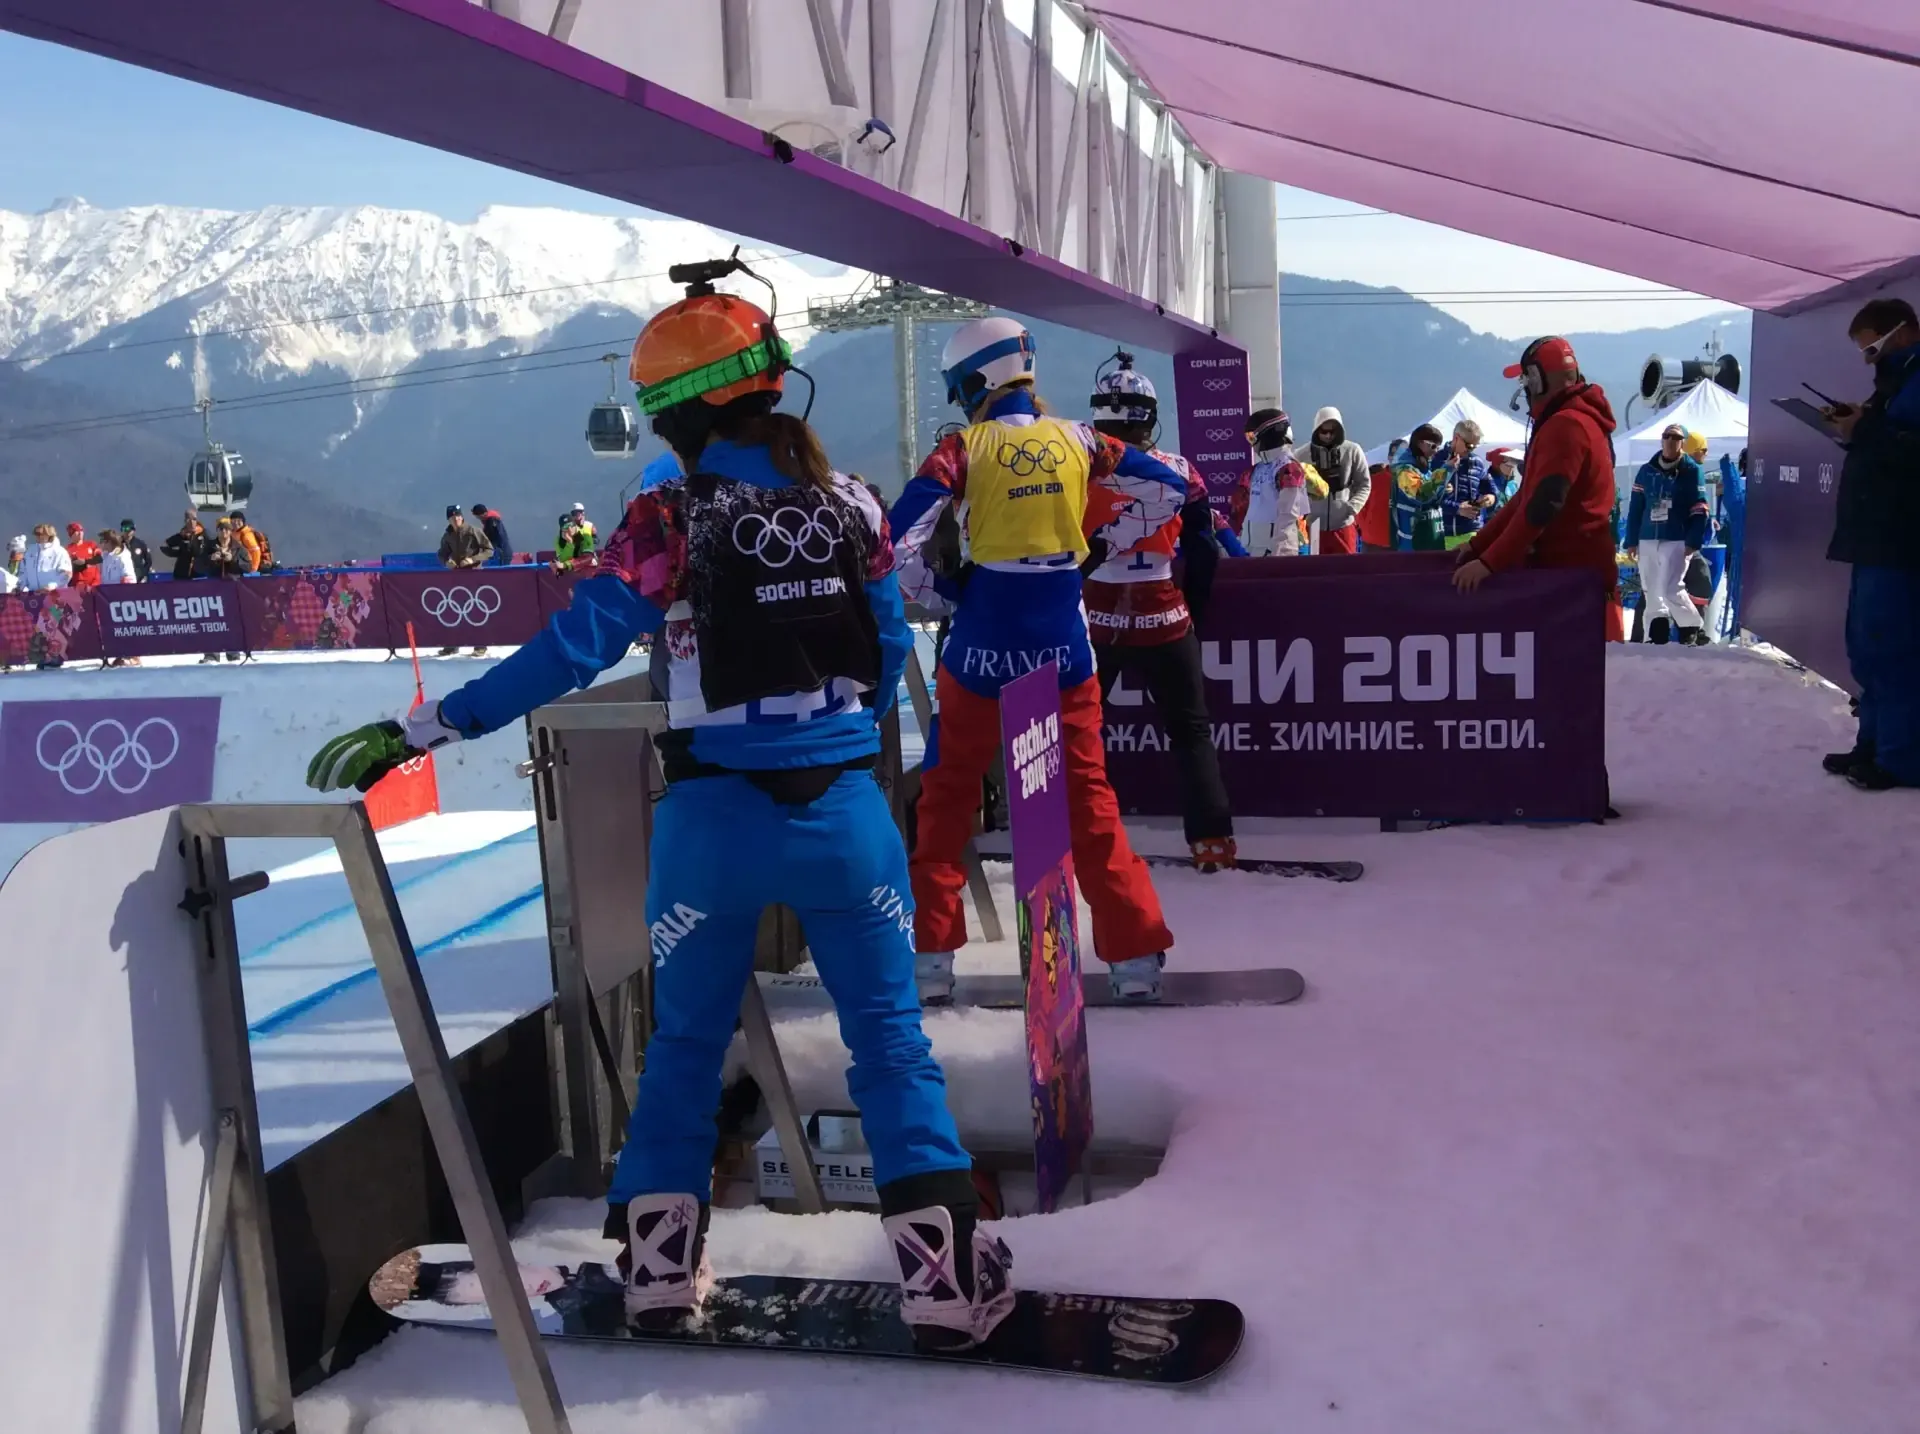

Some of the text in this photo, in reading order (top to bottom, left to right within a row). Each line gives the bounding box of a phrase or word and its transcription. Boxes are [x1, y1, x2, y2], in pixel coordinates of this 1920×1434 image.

[1219, 358, 1242, 367] 2014
[1193, 407, 1243, 418] SOCHI 2014
[1223, 451, 1246, 461] 2014
[1008, 482, 1063, 500] SOCHI 201
[755, 576, 847, 603] SOCHI 2014
[109, 596, 224, 622] СОЧИ 2014
[1088, 609, 1129, 629] CZECH
[114, 621, 230, 637] ЖАРКИЕ. ЗИМНИЕ. ТВОИ.
[962, 645, 1072, 678] FRANCE
[1343, 631, 1535, 702] 2014
[1012, 711, 1059, 771] sochi.ru
[1106, 718, 1546, 752] ЖАИЕ. ЗИМНИЕ. ТВОИ.
[1020, 753, 1048, 800] 2014
